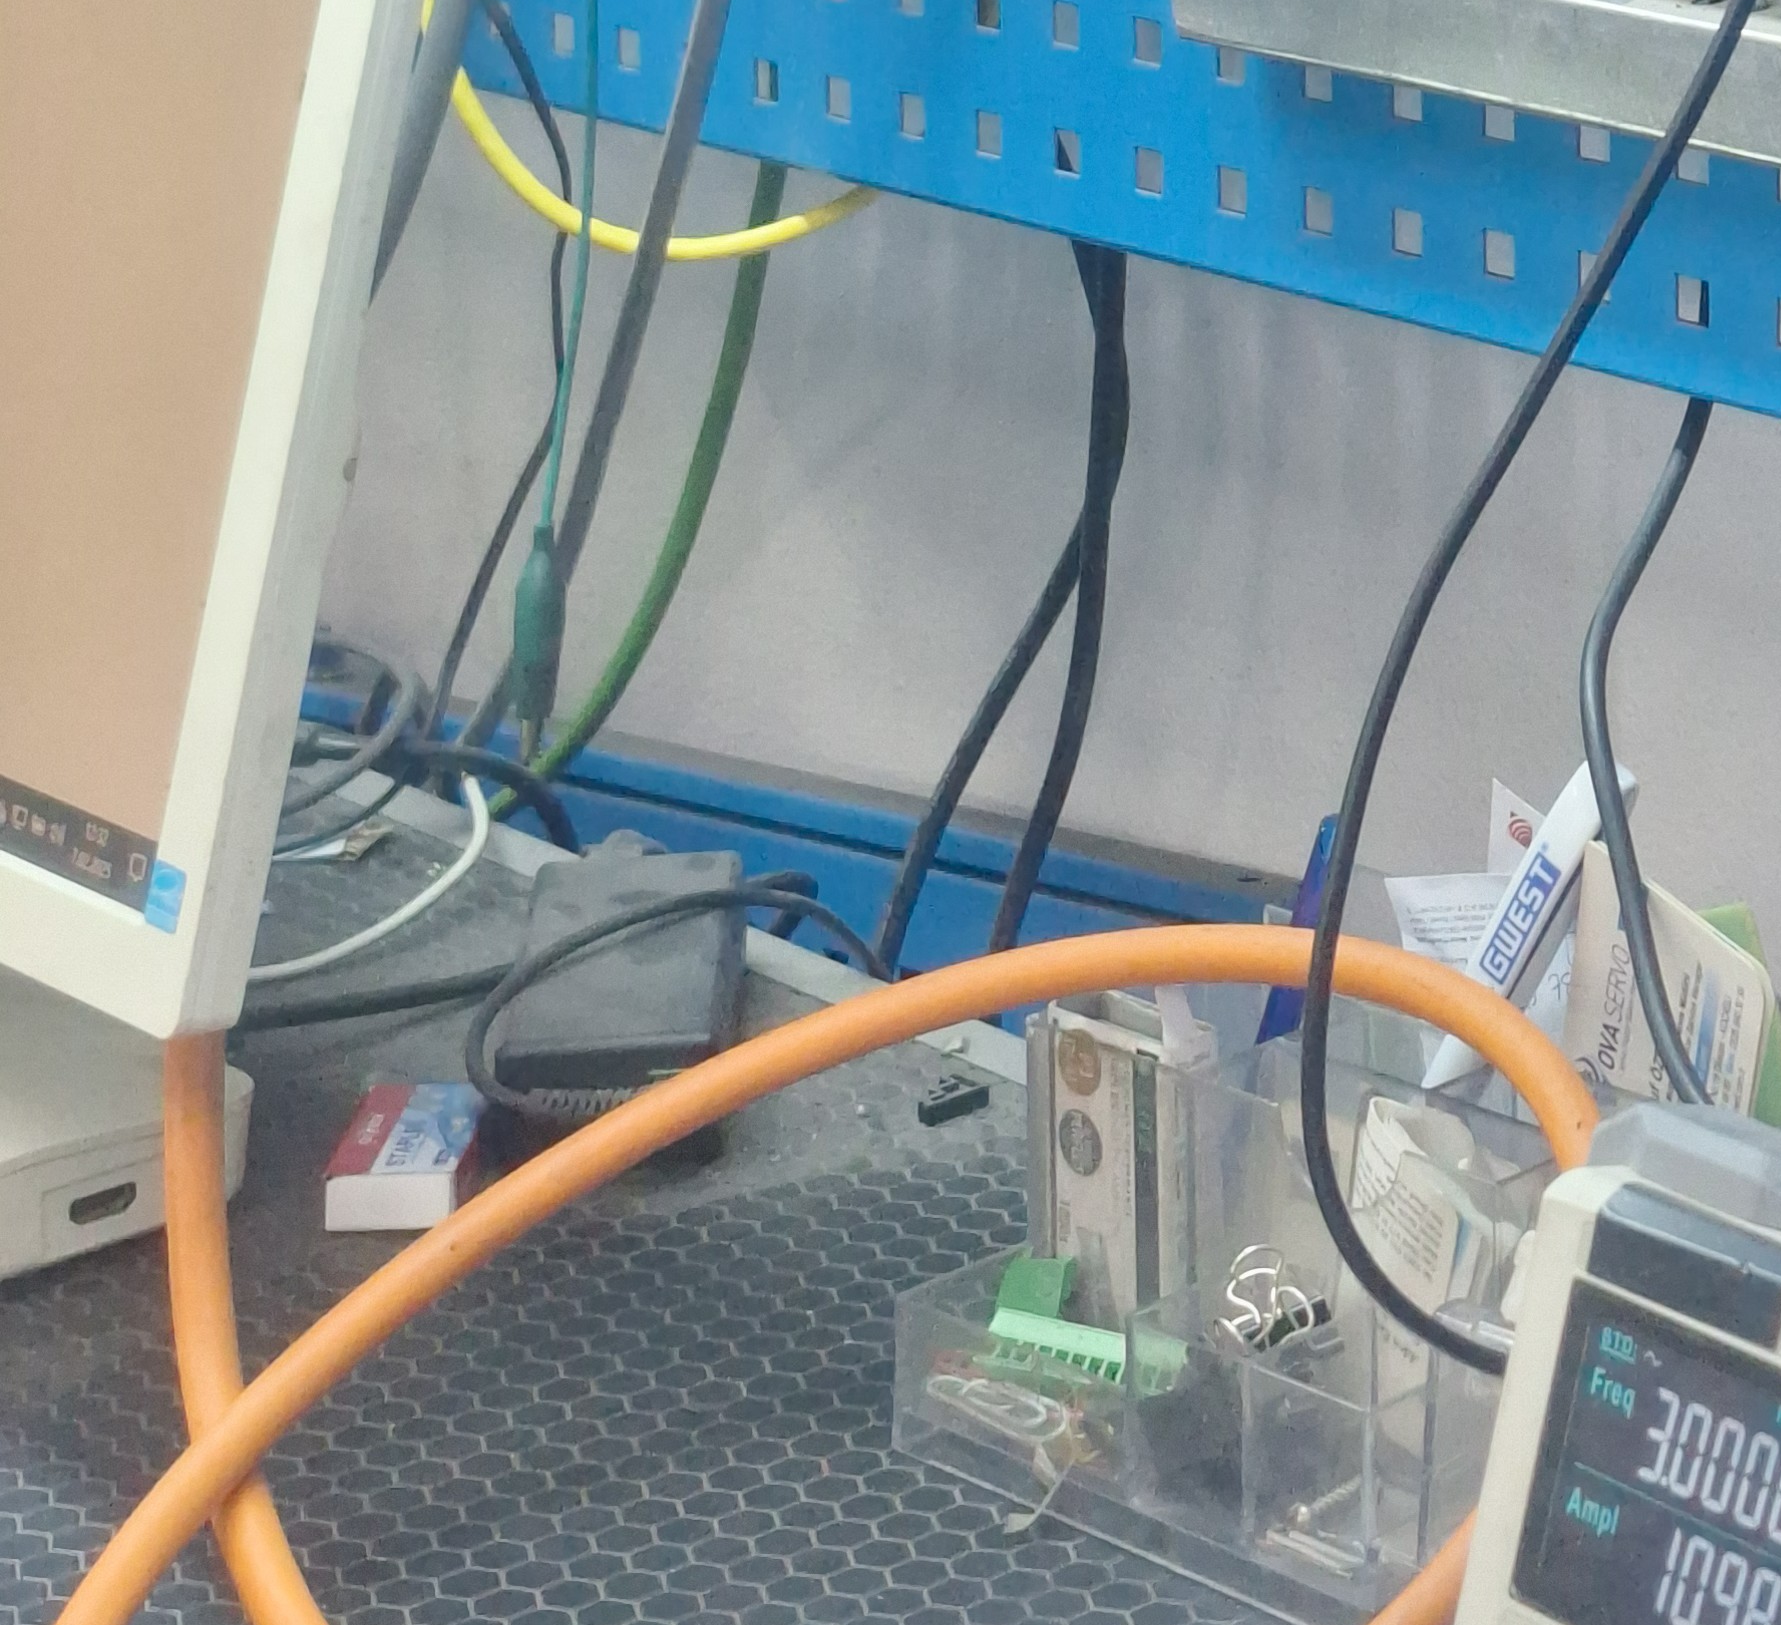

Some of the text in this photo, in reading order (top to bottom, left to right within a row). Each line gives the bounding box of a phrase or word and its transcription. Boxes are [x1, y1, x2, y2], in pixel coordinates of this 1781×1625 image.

[1482, 854, 1558, 985] GWEST
[1604, 944, 1631, 1023] SERVO
[1589, 1366, 1637, 1420] Freq
[1565, 1486, 1621, 1538] Ampl
